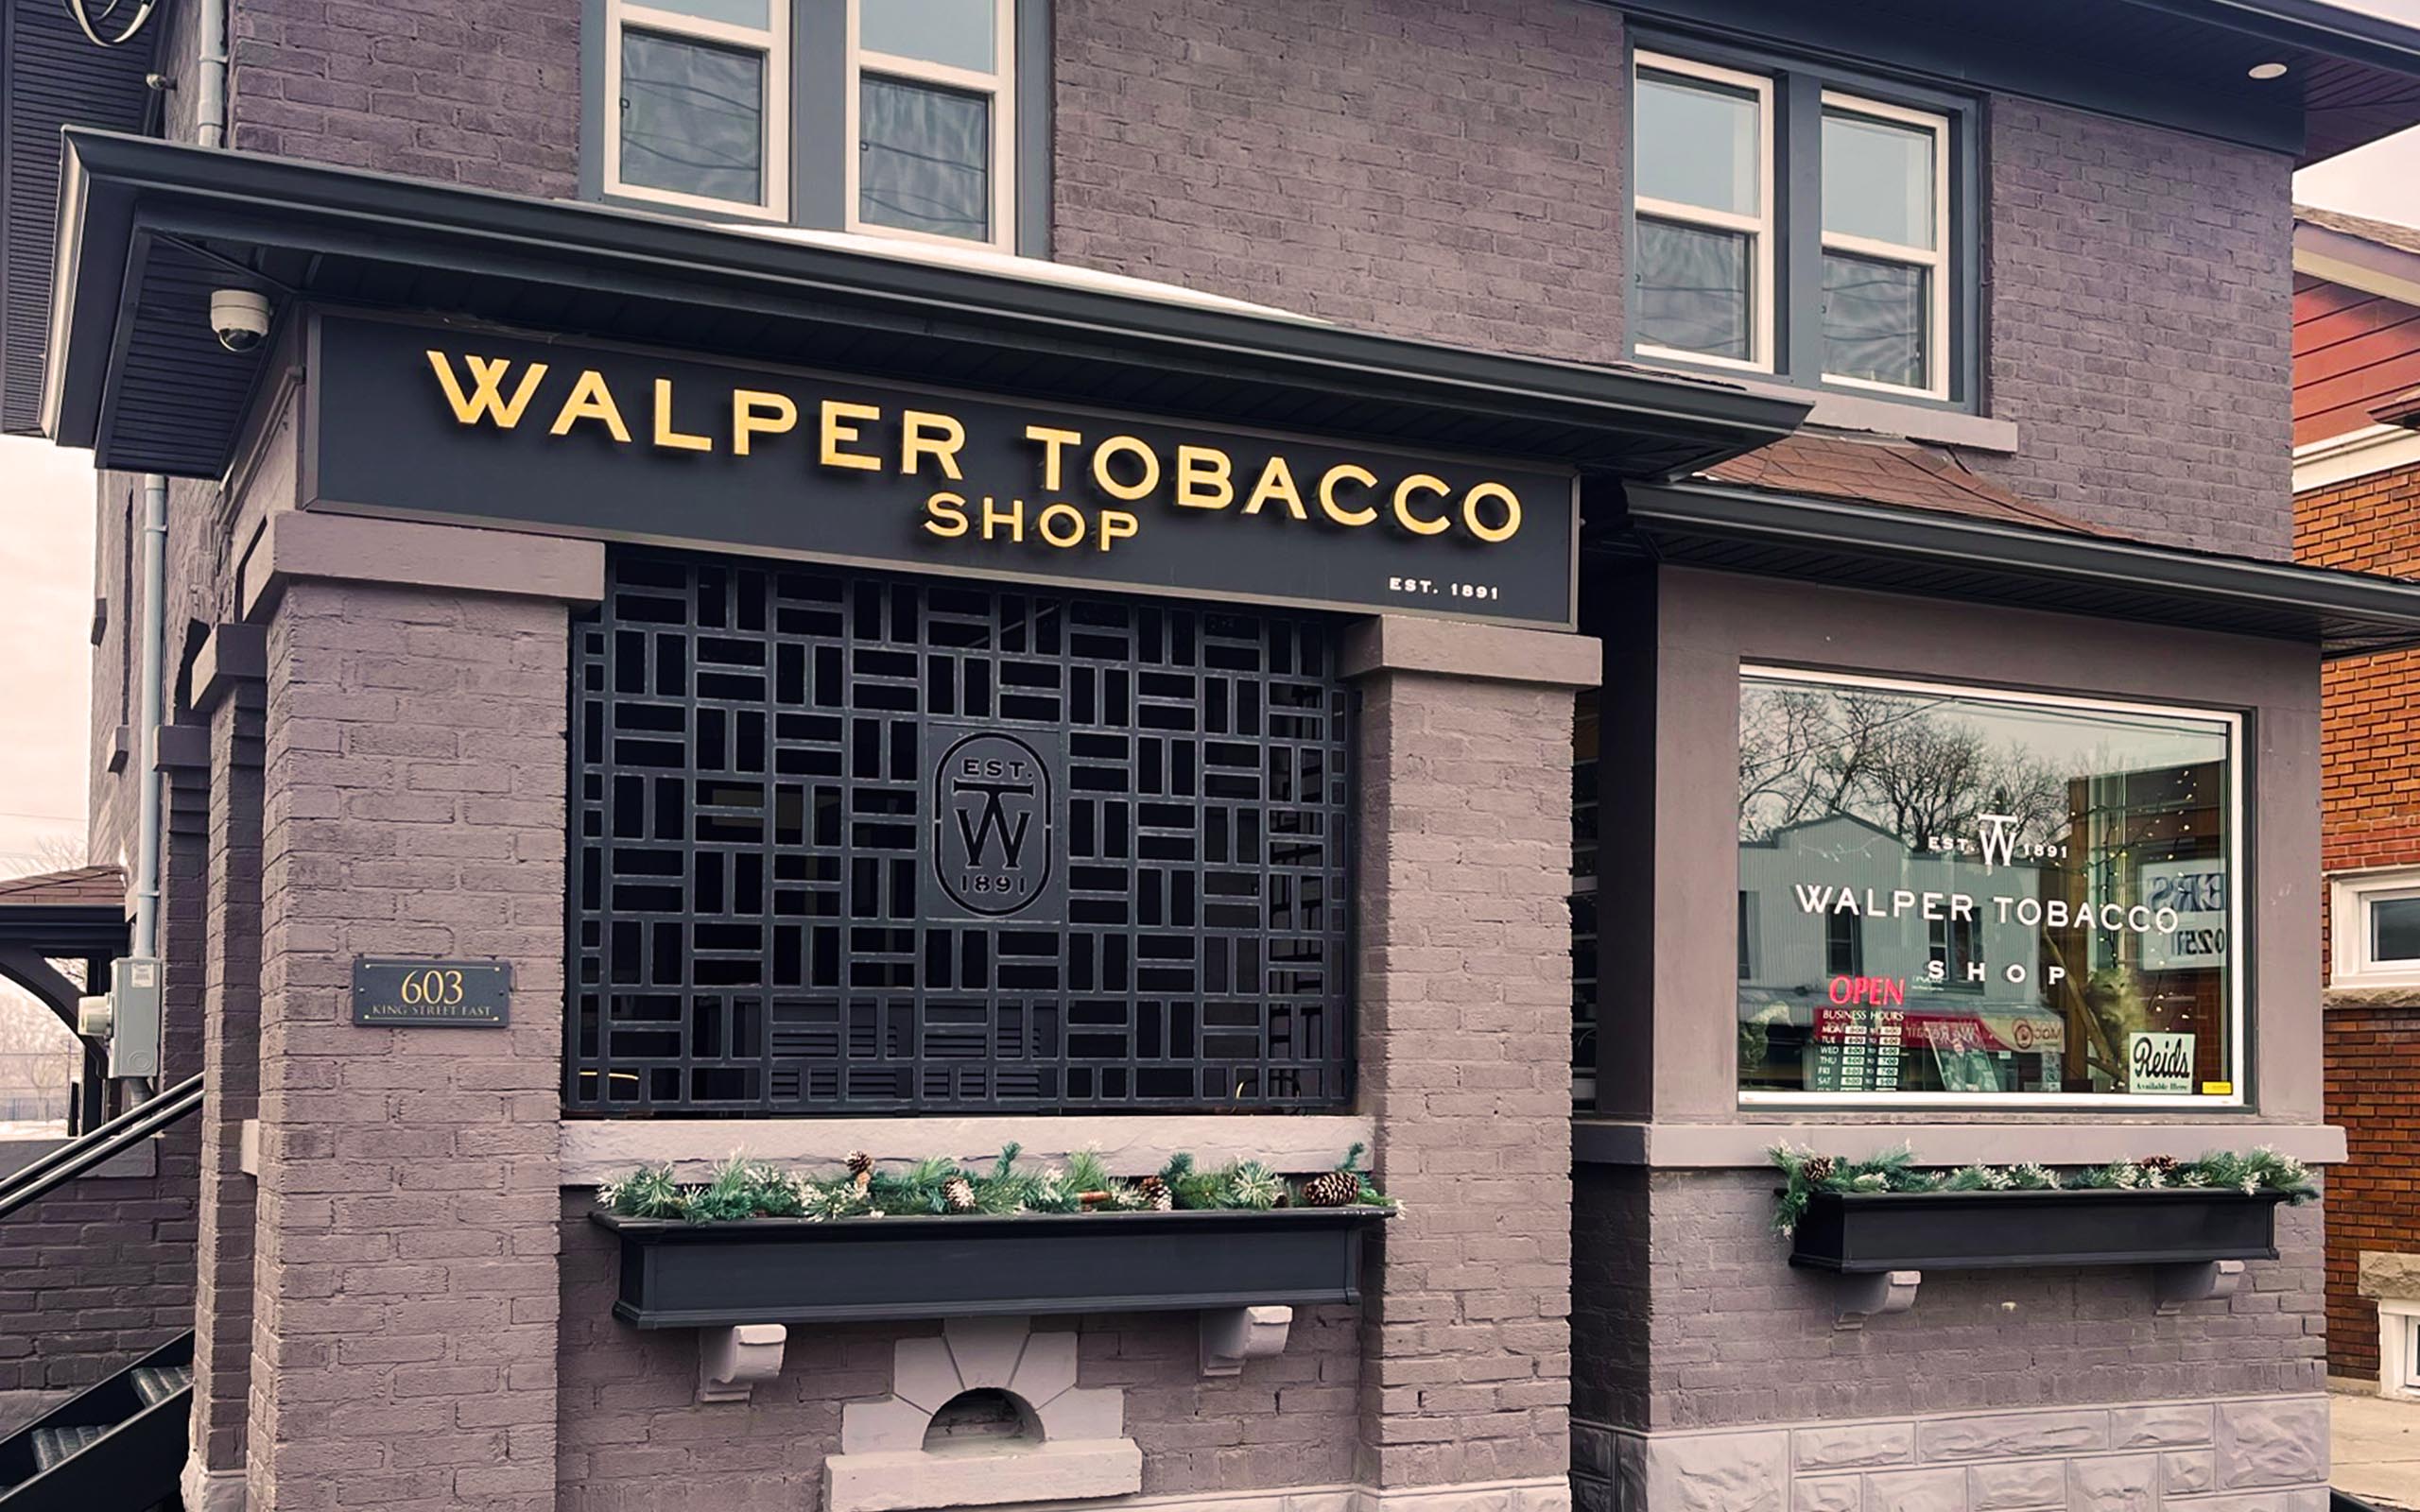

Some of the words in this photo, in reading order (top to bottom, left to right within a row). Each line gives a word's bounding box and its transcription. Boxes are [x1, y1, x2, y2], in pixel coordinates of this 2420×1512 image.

[425, 350, 966, 480] WALPER
[1026, 425, 1522, 542] TOBACCO
[925, 491, 1139, 552] SHOP
[1389, 576, 1439, 593] EST.
[1451, 583, 1498, 600] 1891
[962, 758, 1033, 779] EST.
[1927, 836, 1975, 851] EST.
[2023, 845, 2067, 859] 1891
[960, 875, 1026, 895] 1891
[1796, 885, 1973, 922] WALPER
[1993, 896, 2178, 934] TOBACCO
[1927, 960, 2065, 985] SHOP
[401, 970, 463, 1005] 603
[1829, 974, 1905, 1005] OPEN
[372, 1005, 406, 1015] KING
[412, 1005, 456, 1016] STREET
[461, 1006, 492, 1016] EAST
[1823, 1009, 1867, 1021] BUSINESS
[1870, 1011, 1905, 1022] HOURS
[1820, 1046, 1839, 1055] WED
[2134, 1037, 2190, 1078] Reids
